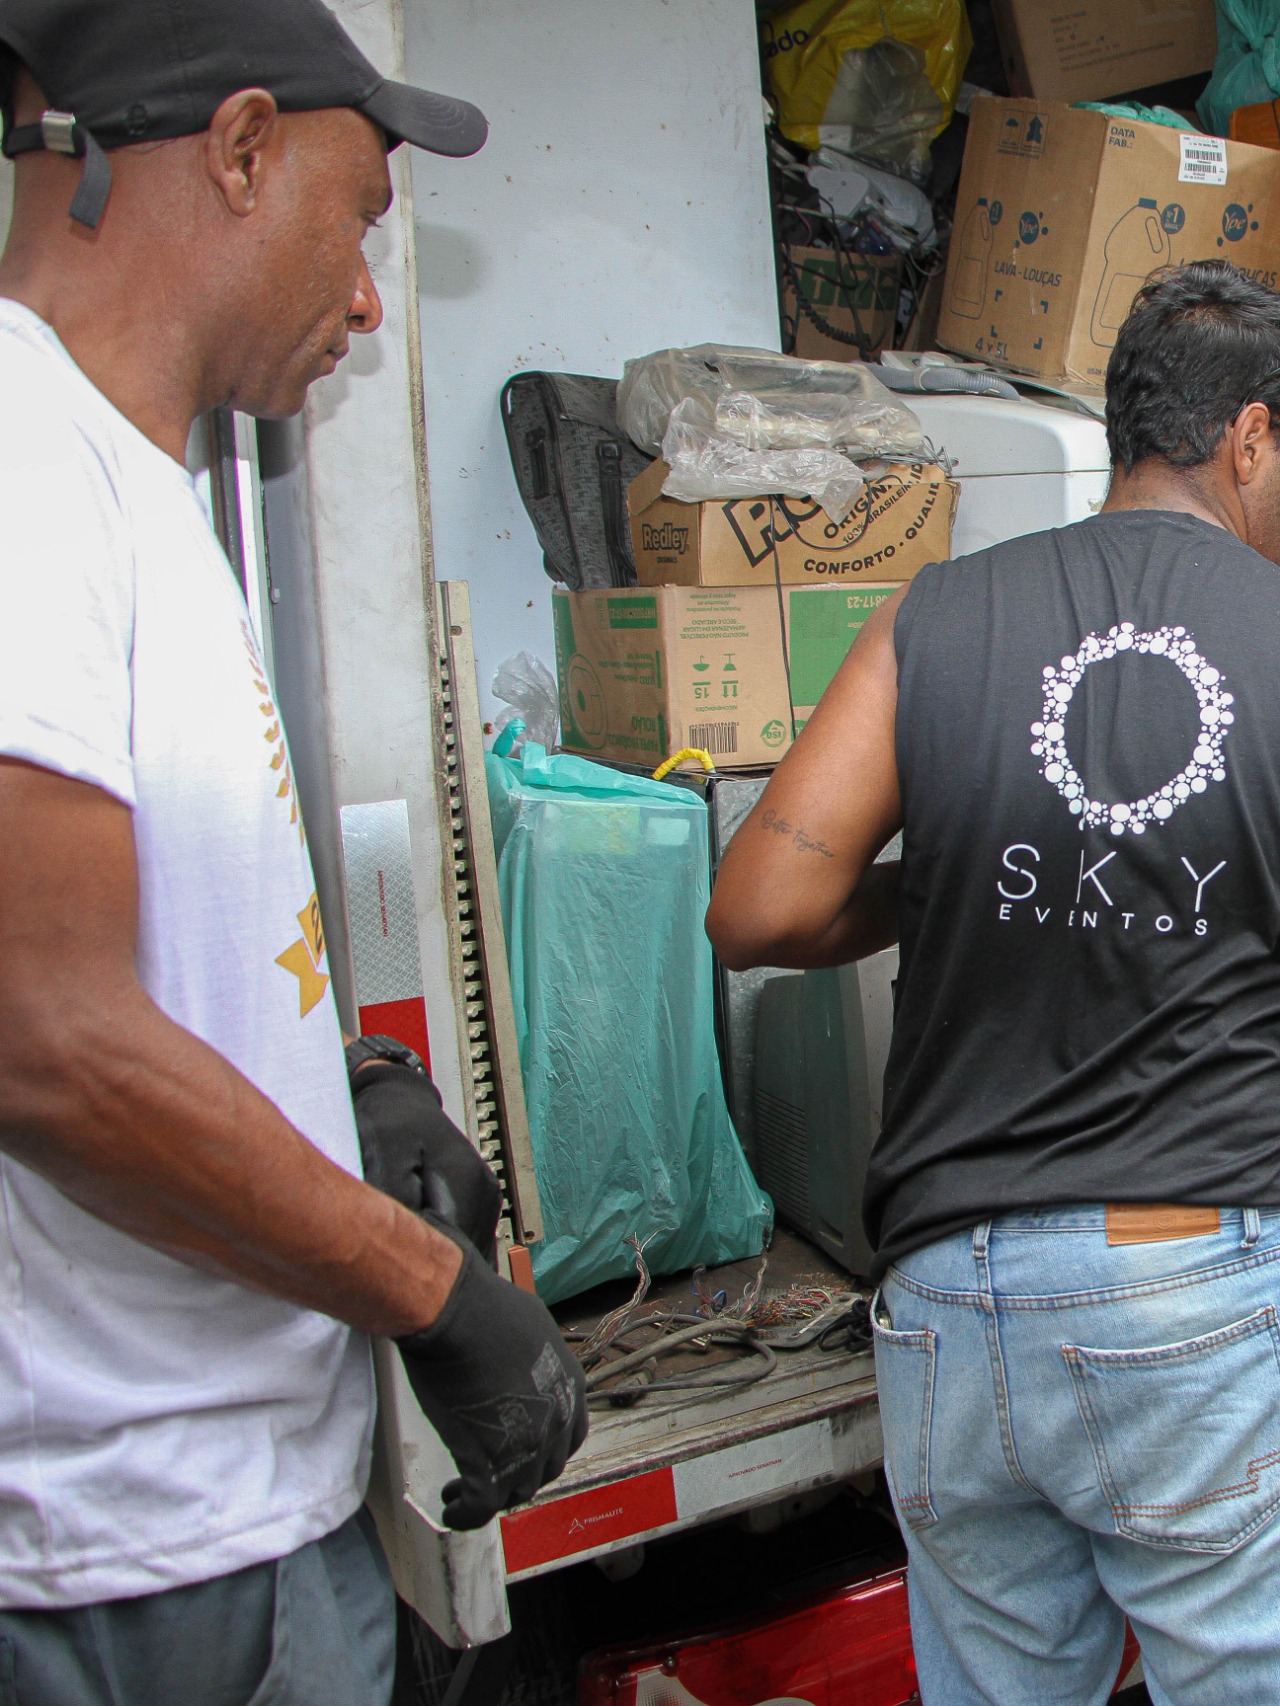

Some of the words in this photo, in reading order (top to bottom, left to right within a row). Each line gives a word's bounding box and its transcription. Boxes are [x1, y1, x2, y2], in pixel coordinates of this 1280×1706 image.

[1110, 126, 1136, 139] DATA
[994, 261, 1017, 277] LAVA
[1023, 267, 1062, 287] LOUÇAS
[975, 337, 984, 351] 4
[642, 522, 689, 555] Redley
[803, 545, 896, 575] CONFORTO
[694, 687, 710, 699] 15
[584, 1507, 624, 1525] PRISMALITE
